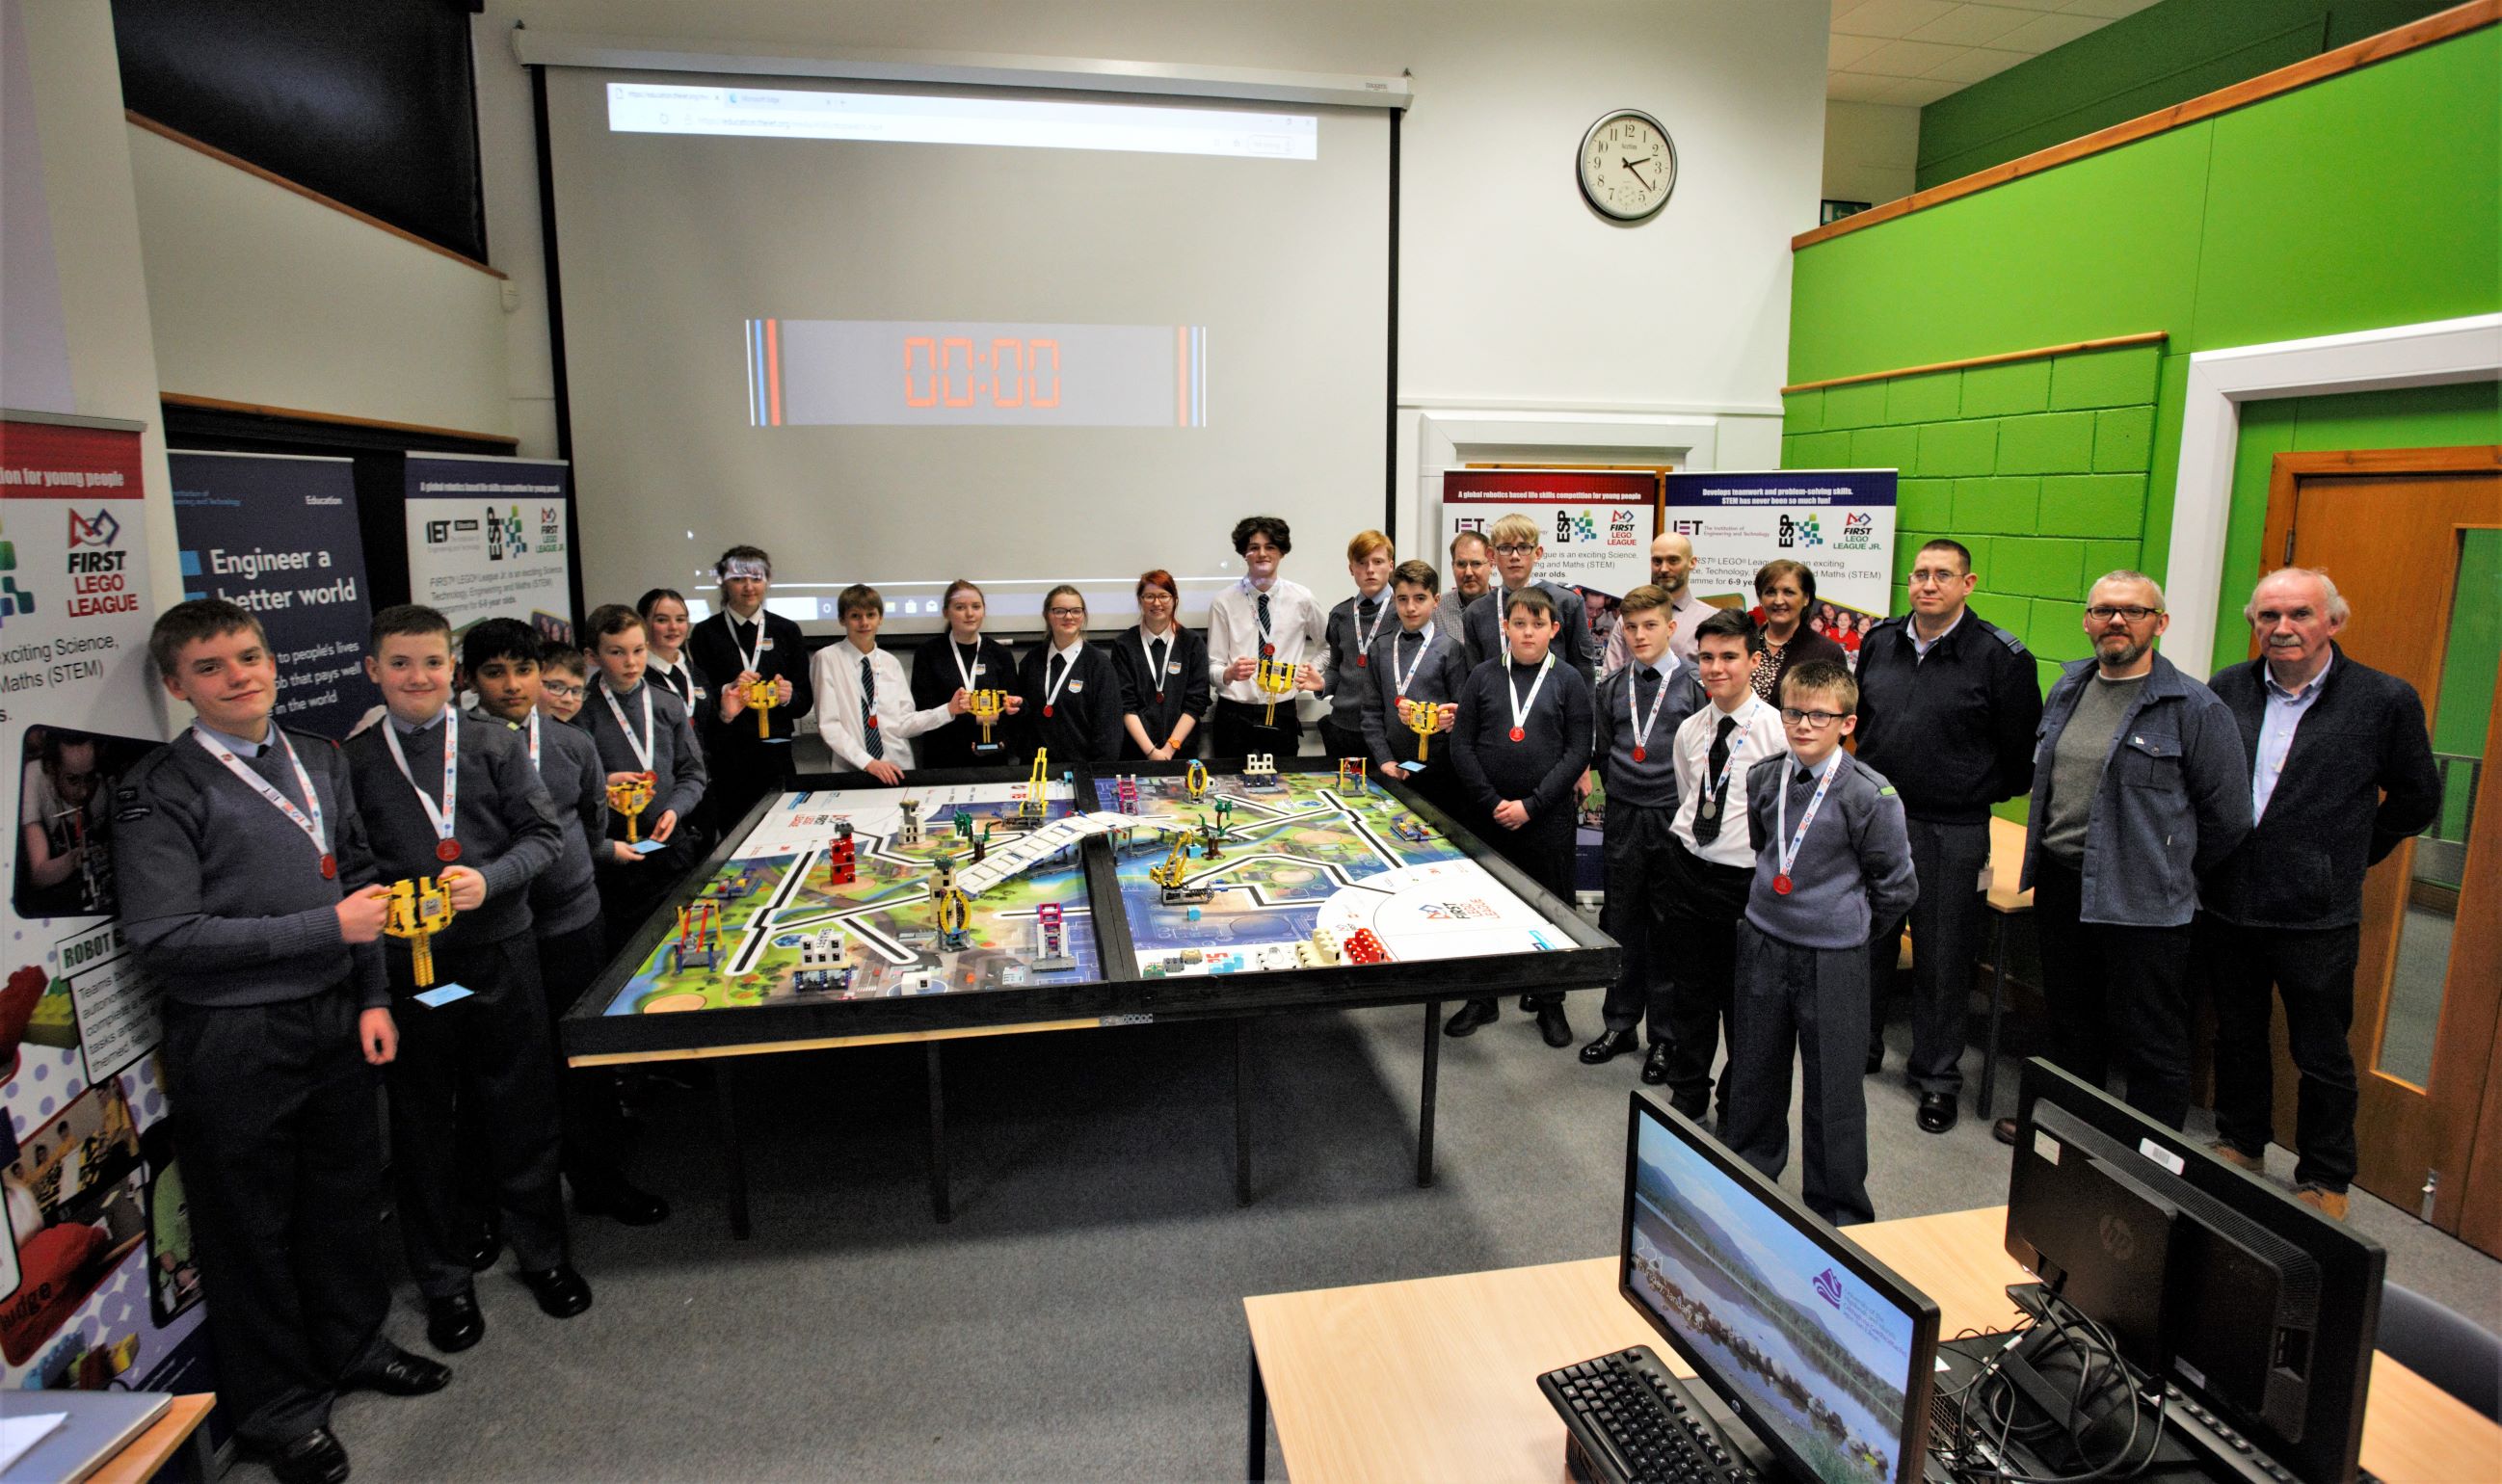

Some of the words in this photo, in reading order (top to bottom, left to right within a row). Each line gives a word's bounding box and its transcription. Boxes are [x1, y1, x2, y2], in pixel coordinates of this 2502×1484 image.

[1610, 128, 1617, 141] 11
[1625, 124, 1635, 137] 12
[1598, 141, 1609, 153] 10
[1652, 144, 1659, 156] 2
[1593, 156, 1601, 169] 9
[1655, 162, 1662, 173] 3
[1597, 174, 1605, 187] 8
[1609, 188, 1614, 200] 7
[1638, 191, 1645, 201] 5
[905, 336, 1059, 409] 00:00
[23, 468, 42, 485] for
[44, 470, 84, 487] young
[85, 471, 124, 488] people
[305, 494, 343, 505] Education
[1539, 490, 1556, 499] skills
[1777, 488, 1831, 496] problem-solving
[541, 525, 559, 535] FIRST
[1455, 518, 1485, 533] IET
[1557, 510, 1571, 543] ESP
[1673, 520, 1703, 535] IET
[1779, 514, 1795, 547] ESP
[487, 506, 503, 561] ESP
[67, 550, 127, 573] FIRST
[1578, 551, 1606, 560] exciting
[209, 547, 311, 580] Engineer
[317, 550, 332, 567] a
[1586, 561, 1615, 570] (STEM)
[1813, 560, 1845, 569] exciting
[1706, 568, 1750, 576] Technology,
[1848, 570, 1881, 580] (STEM)
[74, 573, 124, 595] LEGO
[218, 588, 293, 612] better
[297, 577, 357, 606] world
[67, 594, 139, 618] LEAGUE
[0, 643, 52, 665] xciting
[56, 633, 120, 655] Science,
[277, 652, 291, 663] to
[292, 644, 335, 665] people's
[335, 641, 359, 653] lives
[48, 659, 103, 688] (STEM)
[289, 673, 313, 686] that
[314, 670, 340, 685] pays
[340, 661, 362, 676] well
[287, 698, 307, 712] the
[308, 689, 338, 706] world
[64, 932, 110, 968] ROBOT
[78, 976, 113, 999] Teams
[89, 1033, 117, 1056] tasks
